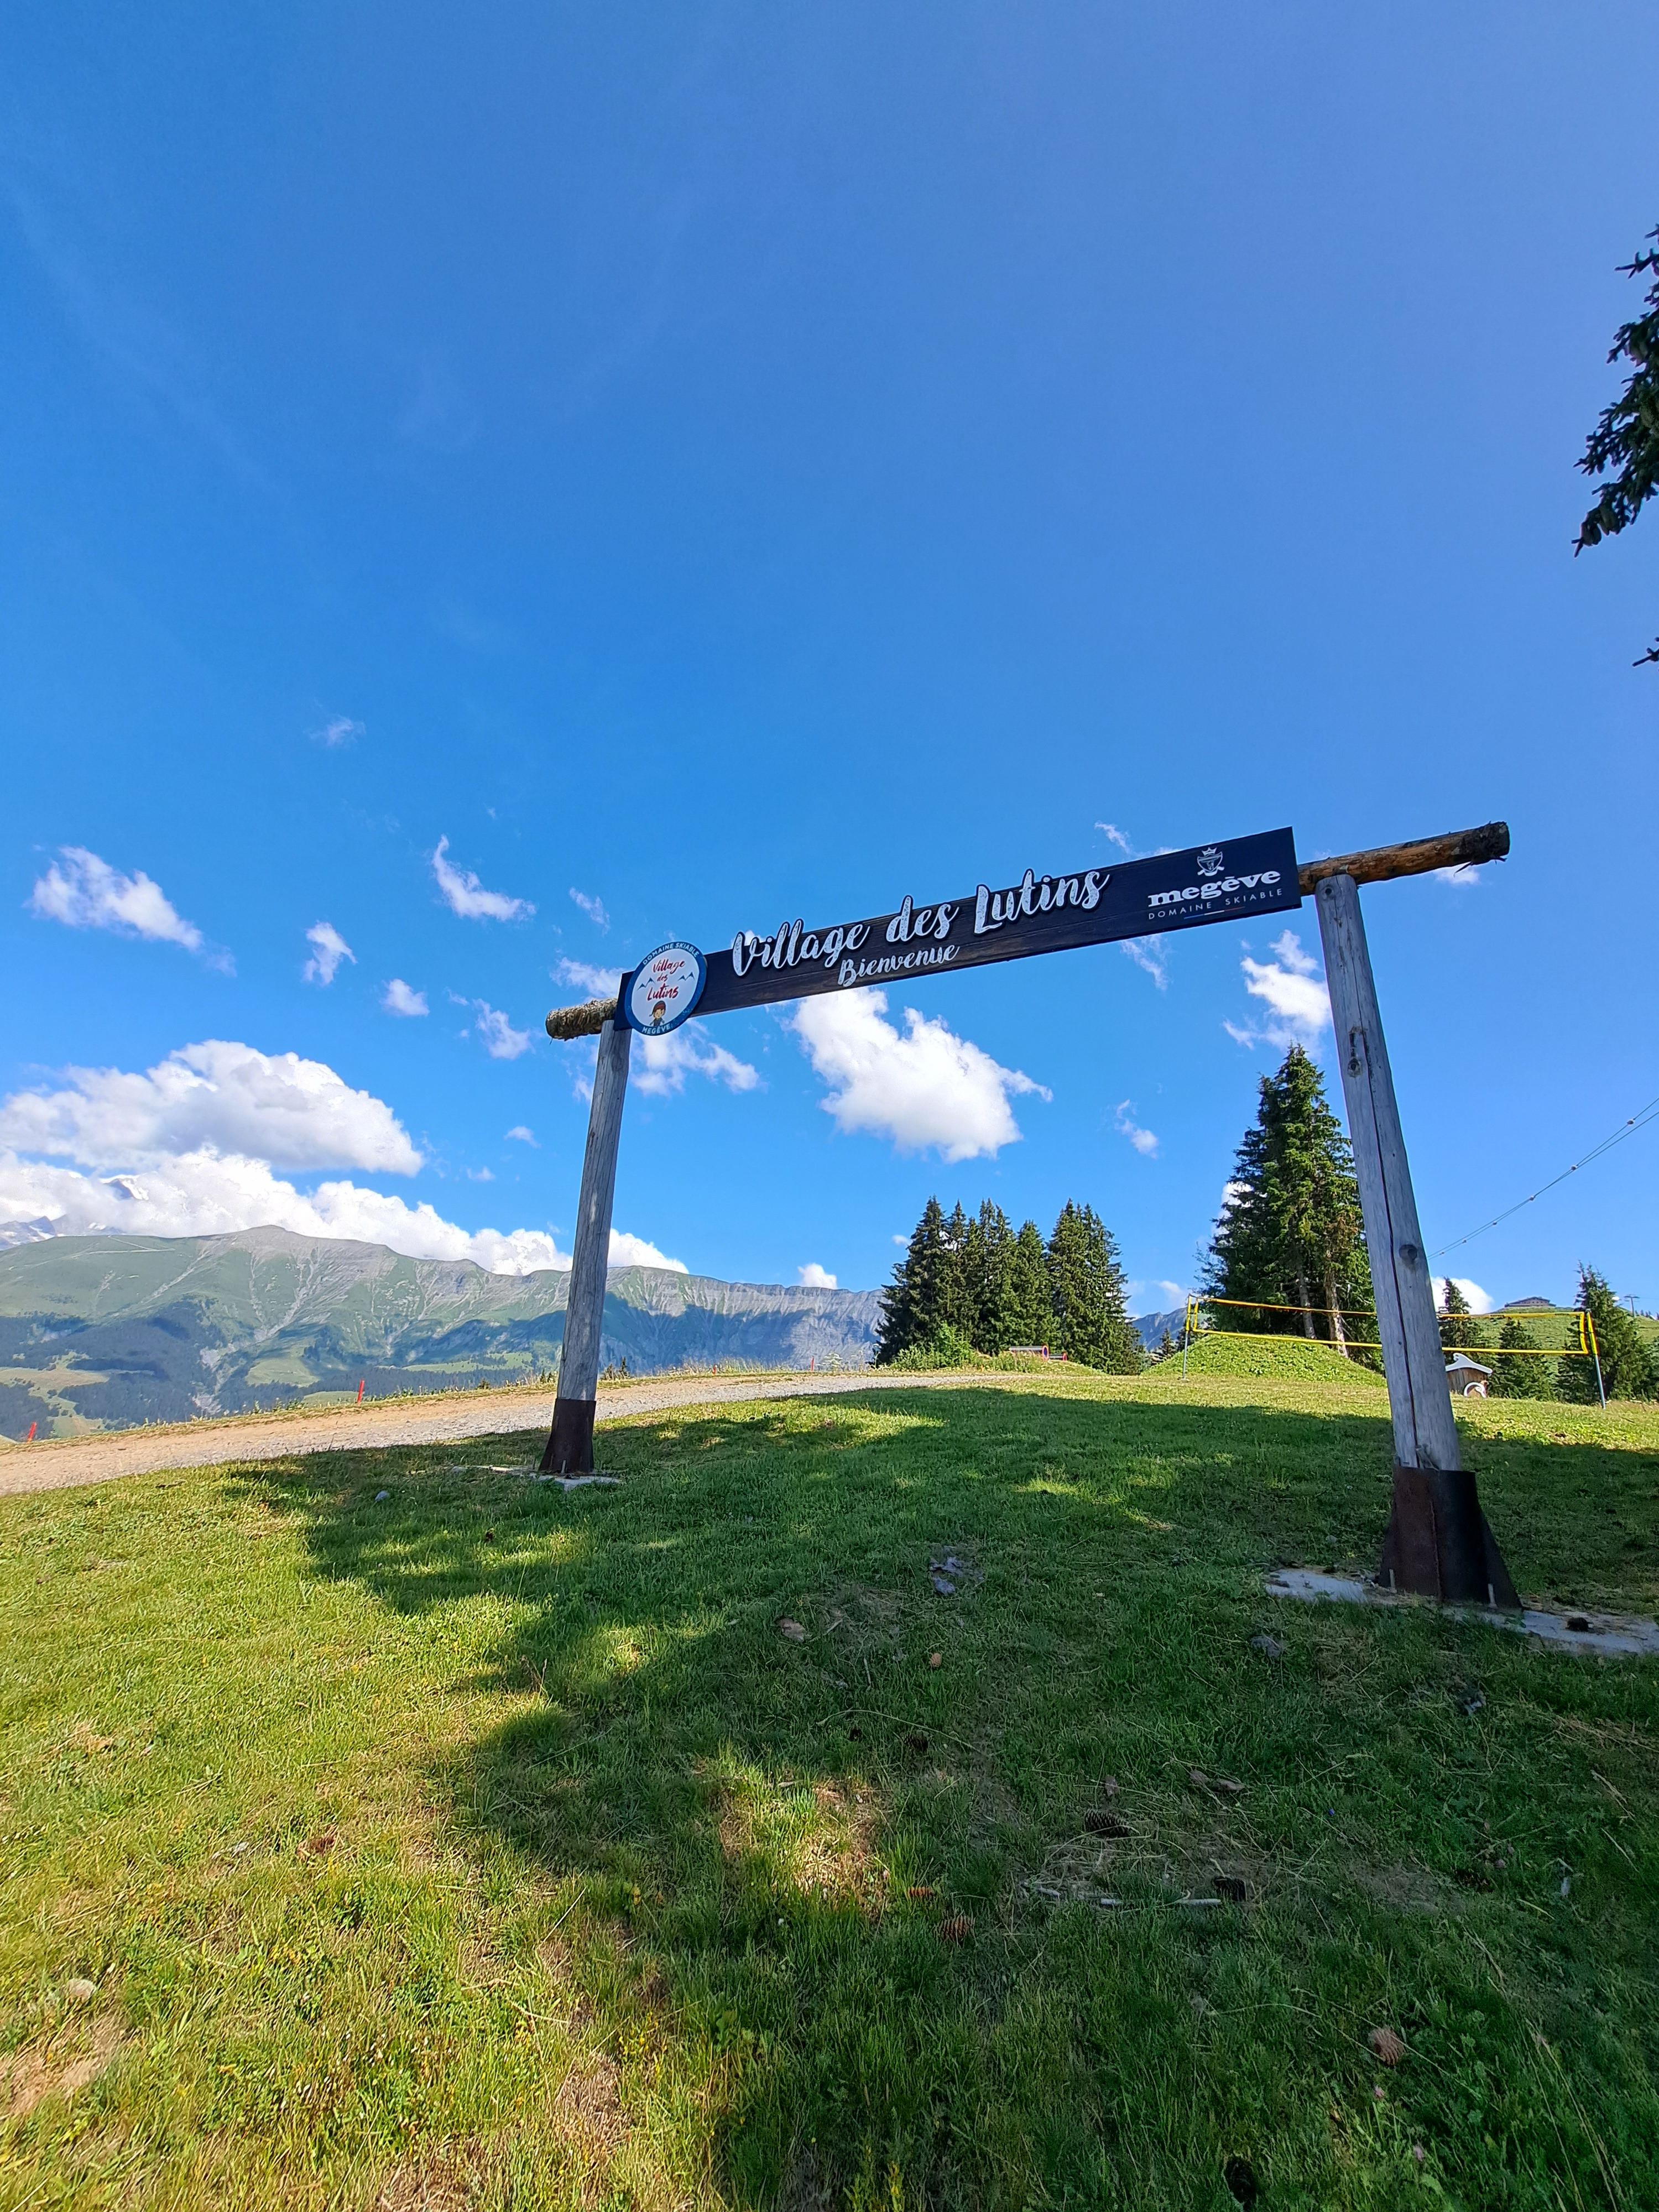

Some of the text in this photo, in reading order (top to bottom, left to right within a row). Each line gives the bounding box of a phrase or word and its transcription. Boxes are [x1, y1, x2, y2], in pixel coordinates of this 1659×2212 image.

[1149, 888, 1282, 920] DOMAINE SKIABLE
[733, 869, 1109, 976] Village des Lutins
[643, 942, 699, 965] DOMAINE SKIABLE
[653, 958, 685, 974] Village
[838, 945, 959, 986] Bienvenue
[657, 973, 668, 982] des
[647, 983, 679, 1000] Lutins
